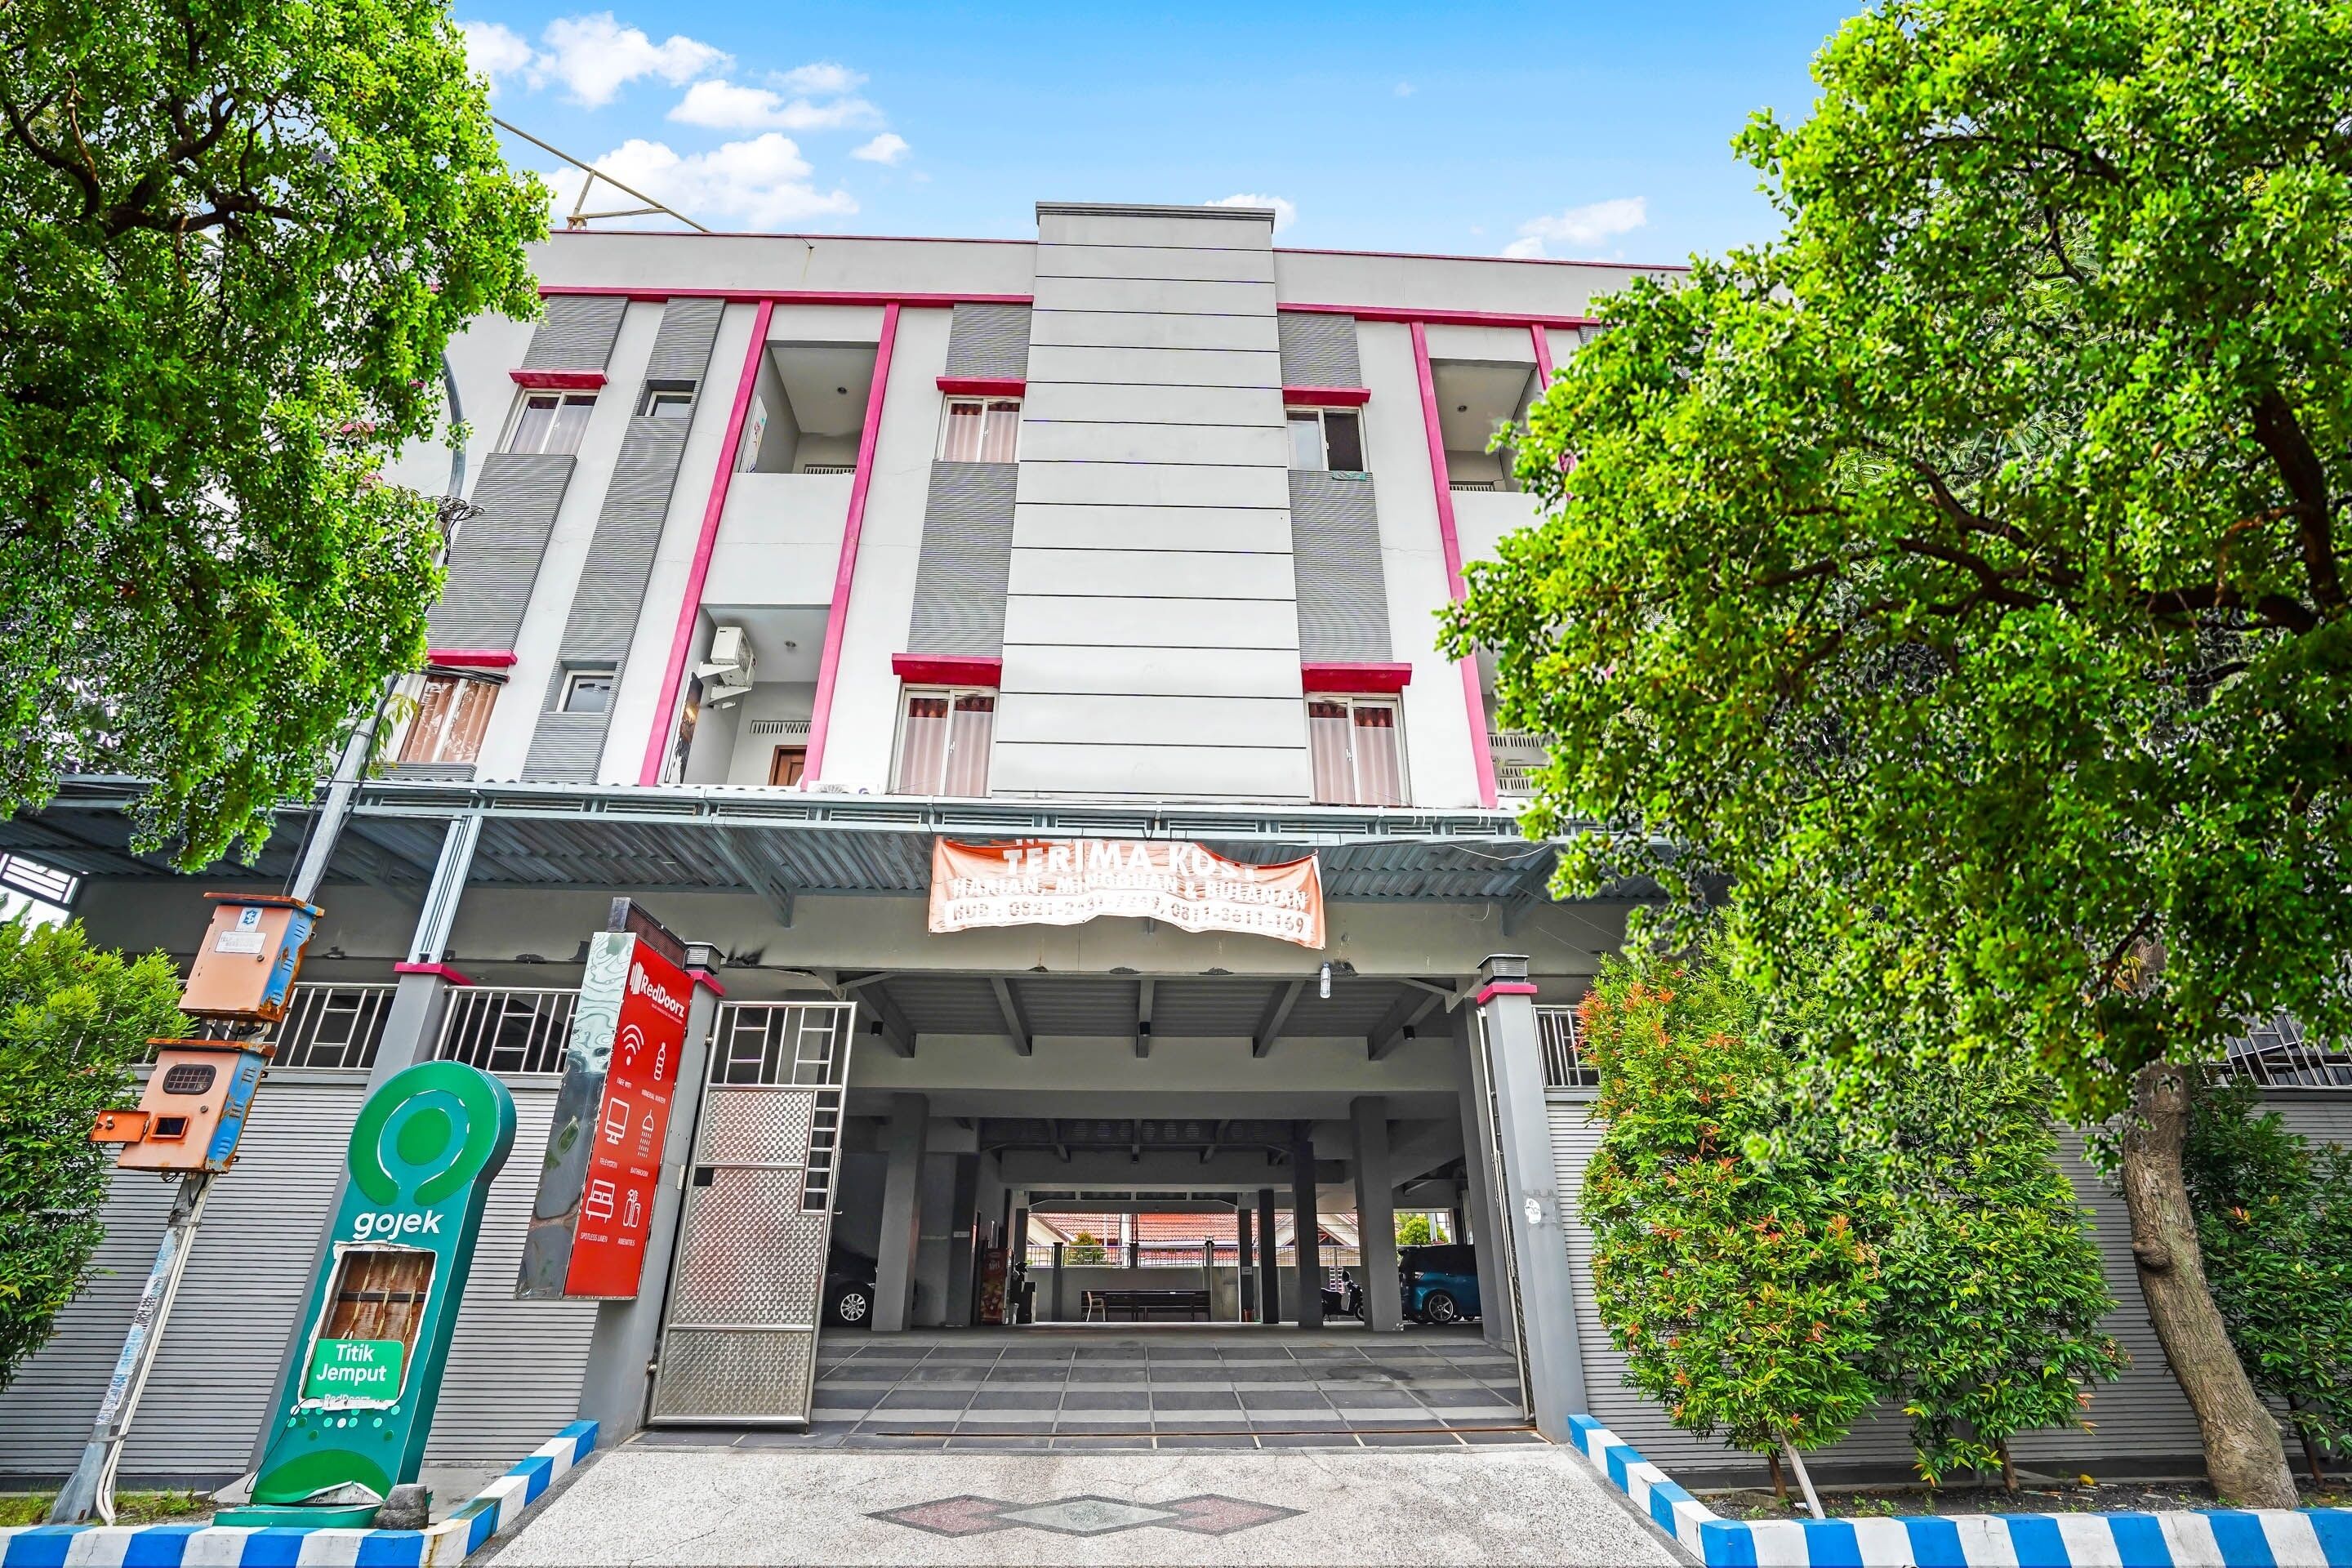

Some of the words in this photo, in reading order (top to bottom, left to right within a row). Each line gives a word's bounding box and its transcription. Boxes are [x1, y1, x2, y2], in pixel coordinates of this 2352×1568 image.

[1003, 839, 1153, 876] TERIMA
[640, 973, 685, 1018] RedDoorz
[352, 1209, 444, 1240] gojek
[336, 1343, 376, 1362] Titik
[316, 1363, 388, 1387] Jemput
